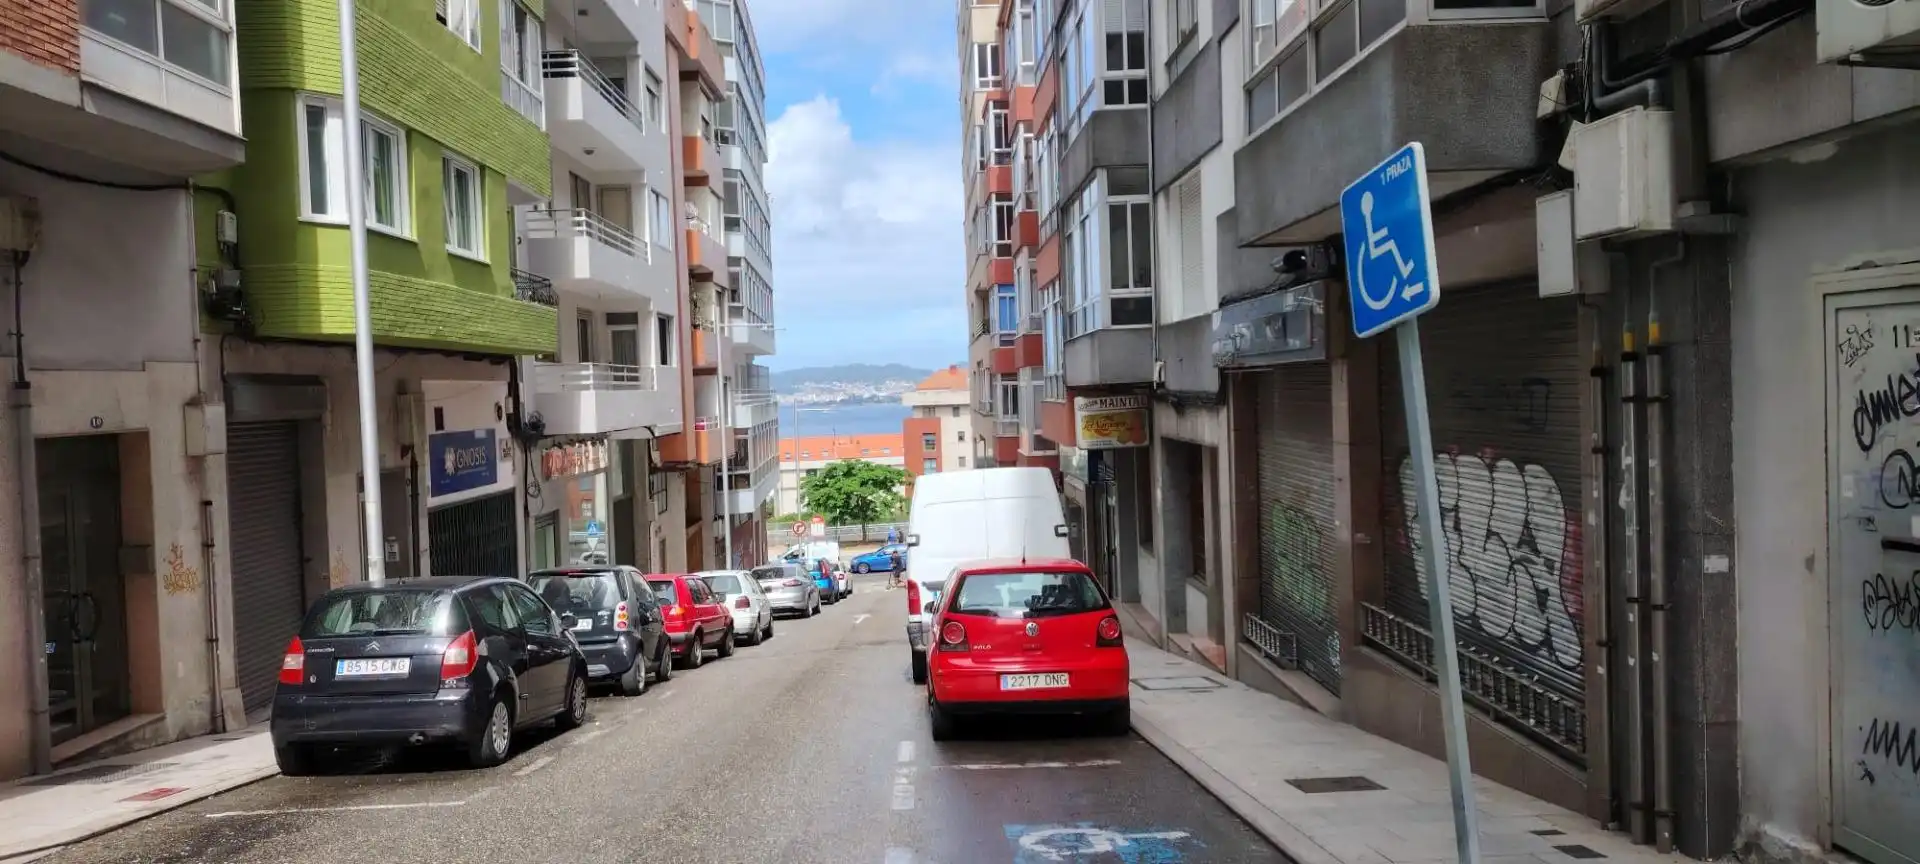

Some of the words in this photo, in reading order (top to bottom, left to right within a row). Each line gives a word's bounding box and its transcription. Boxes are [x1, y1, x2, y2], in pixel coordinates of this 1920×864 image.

[1386, 156, 1411, 183] PRAZA
[457, 446, 486, 468] GNOSIS
[346, 660, 378, 673] 8515
[1011, 674, 1040, 688] 2217
[1044, 674, 1067, 686] DNG
